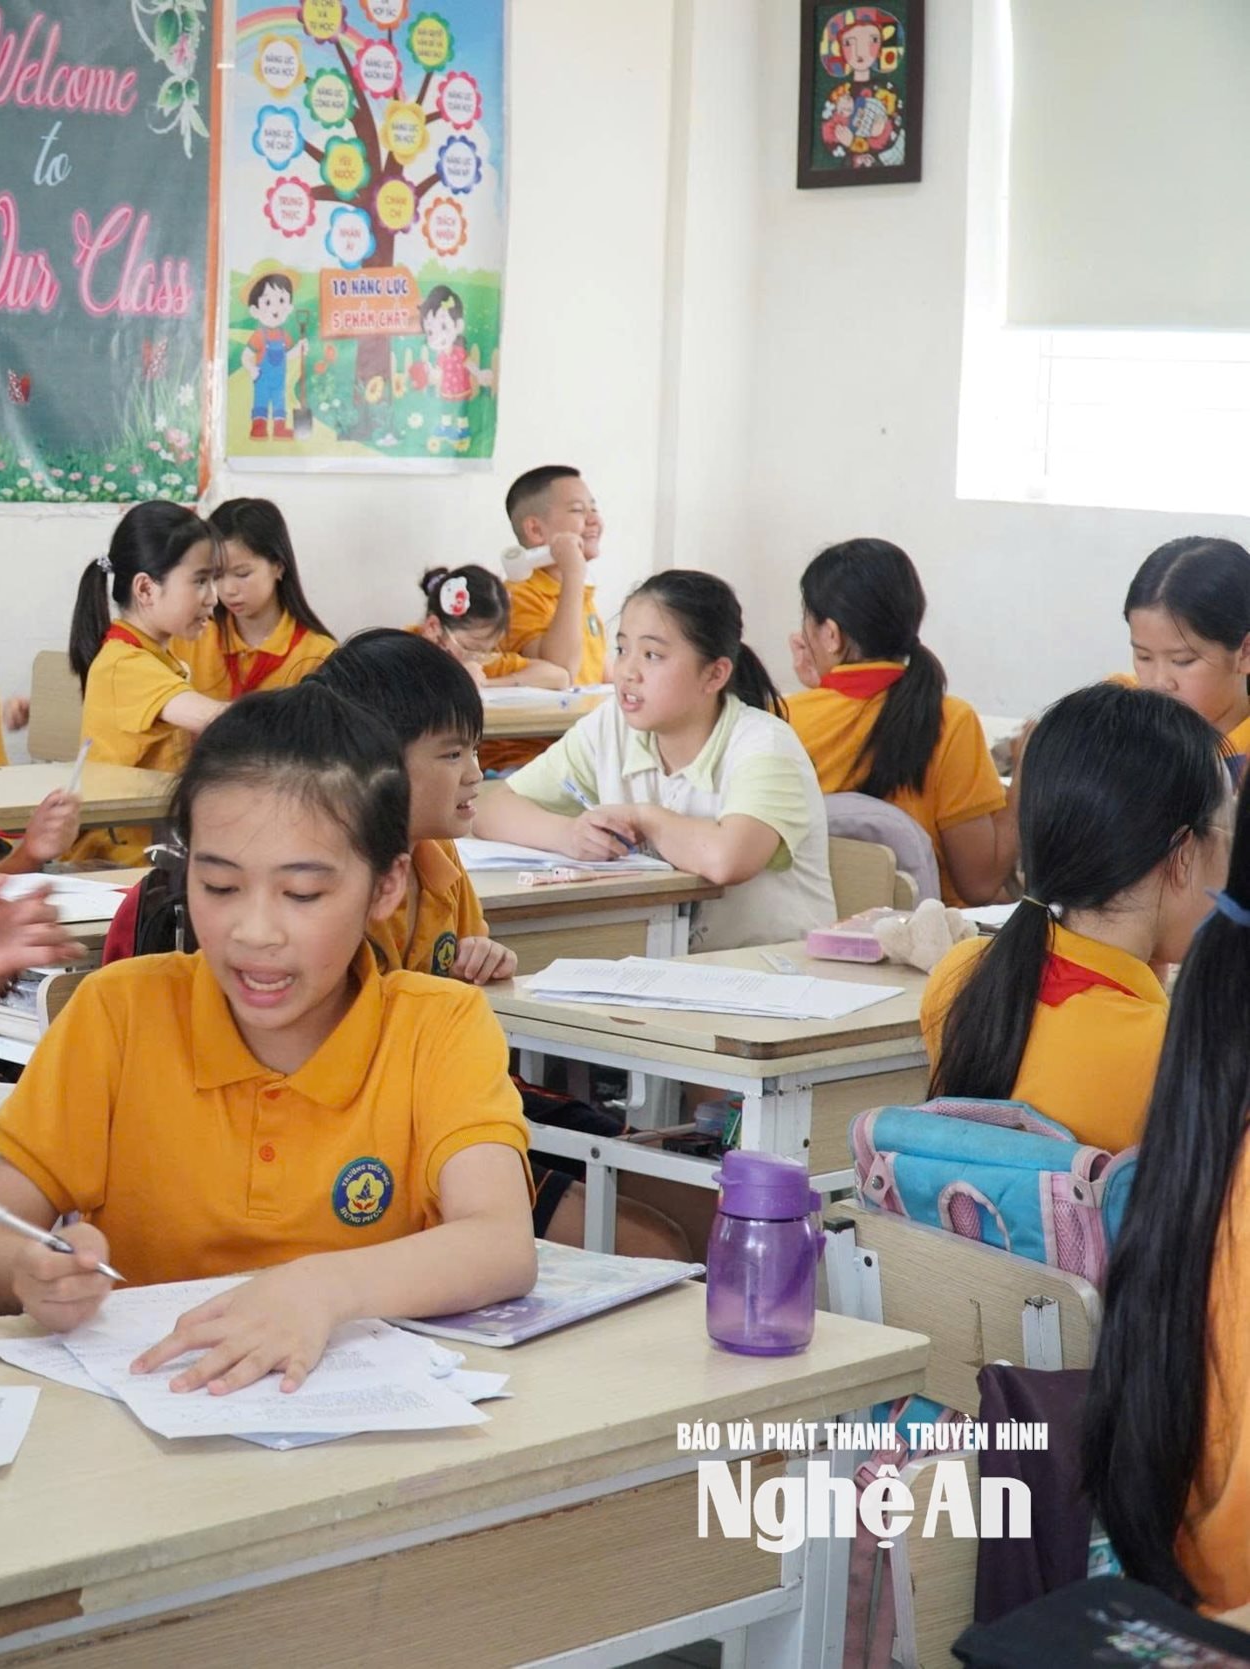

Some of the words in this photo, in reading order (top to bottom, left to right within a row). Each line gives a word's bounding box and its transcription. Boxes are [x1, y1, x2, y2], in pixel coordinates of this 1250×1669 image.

[33, 120, 72, 186] to
[72, 205, 192, 316] Class
[332, 280, 347, 296] 10
[333, 312, 341, 329] 5
